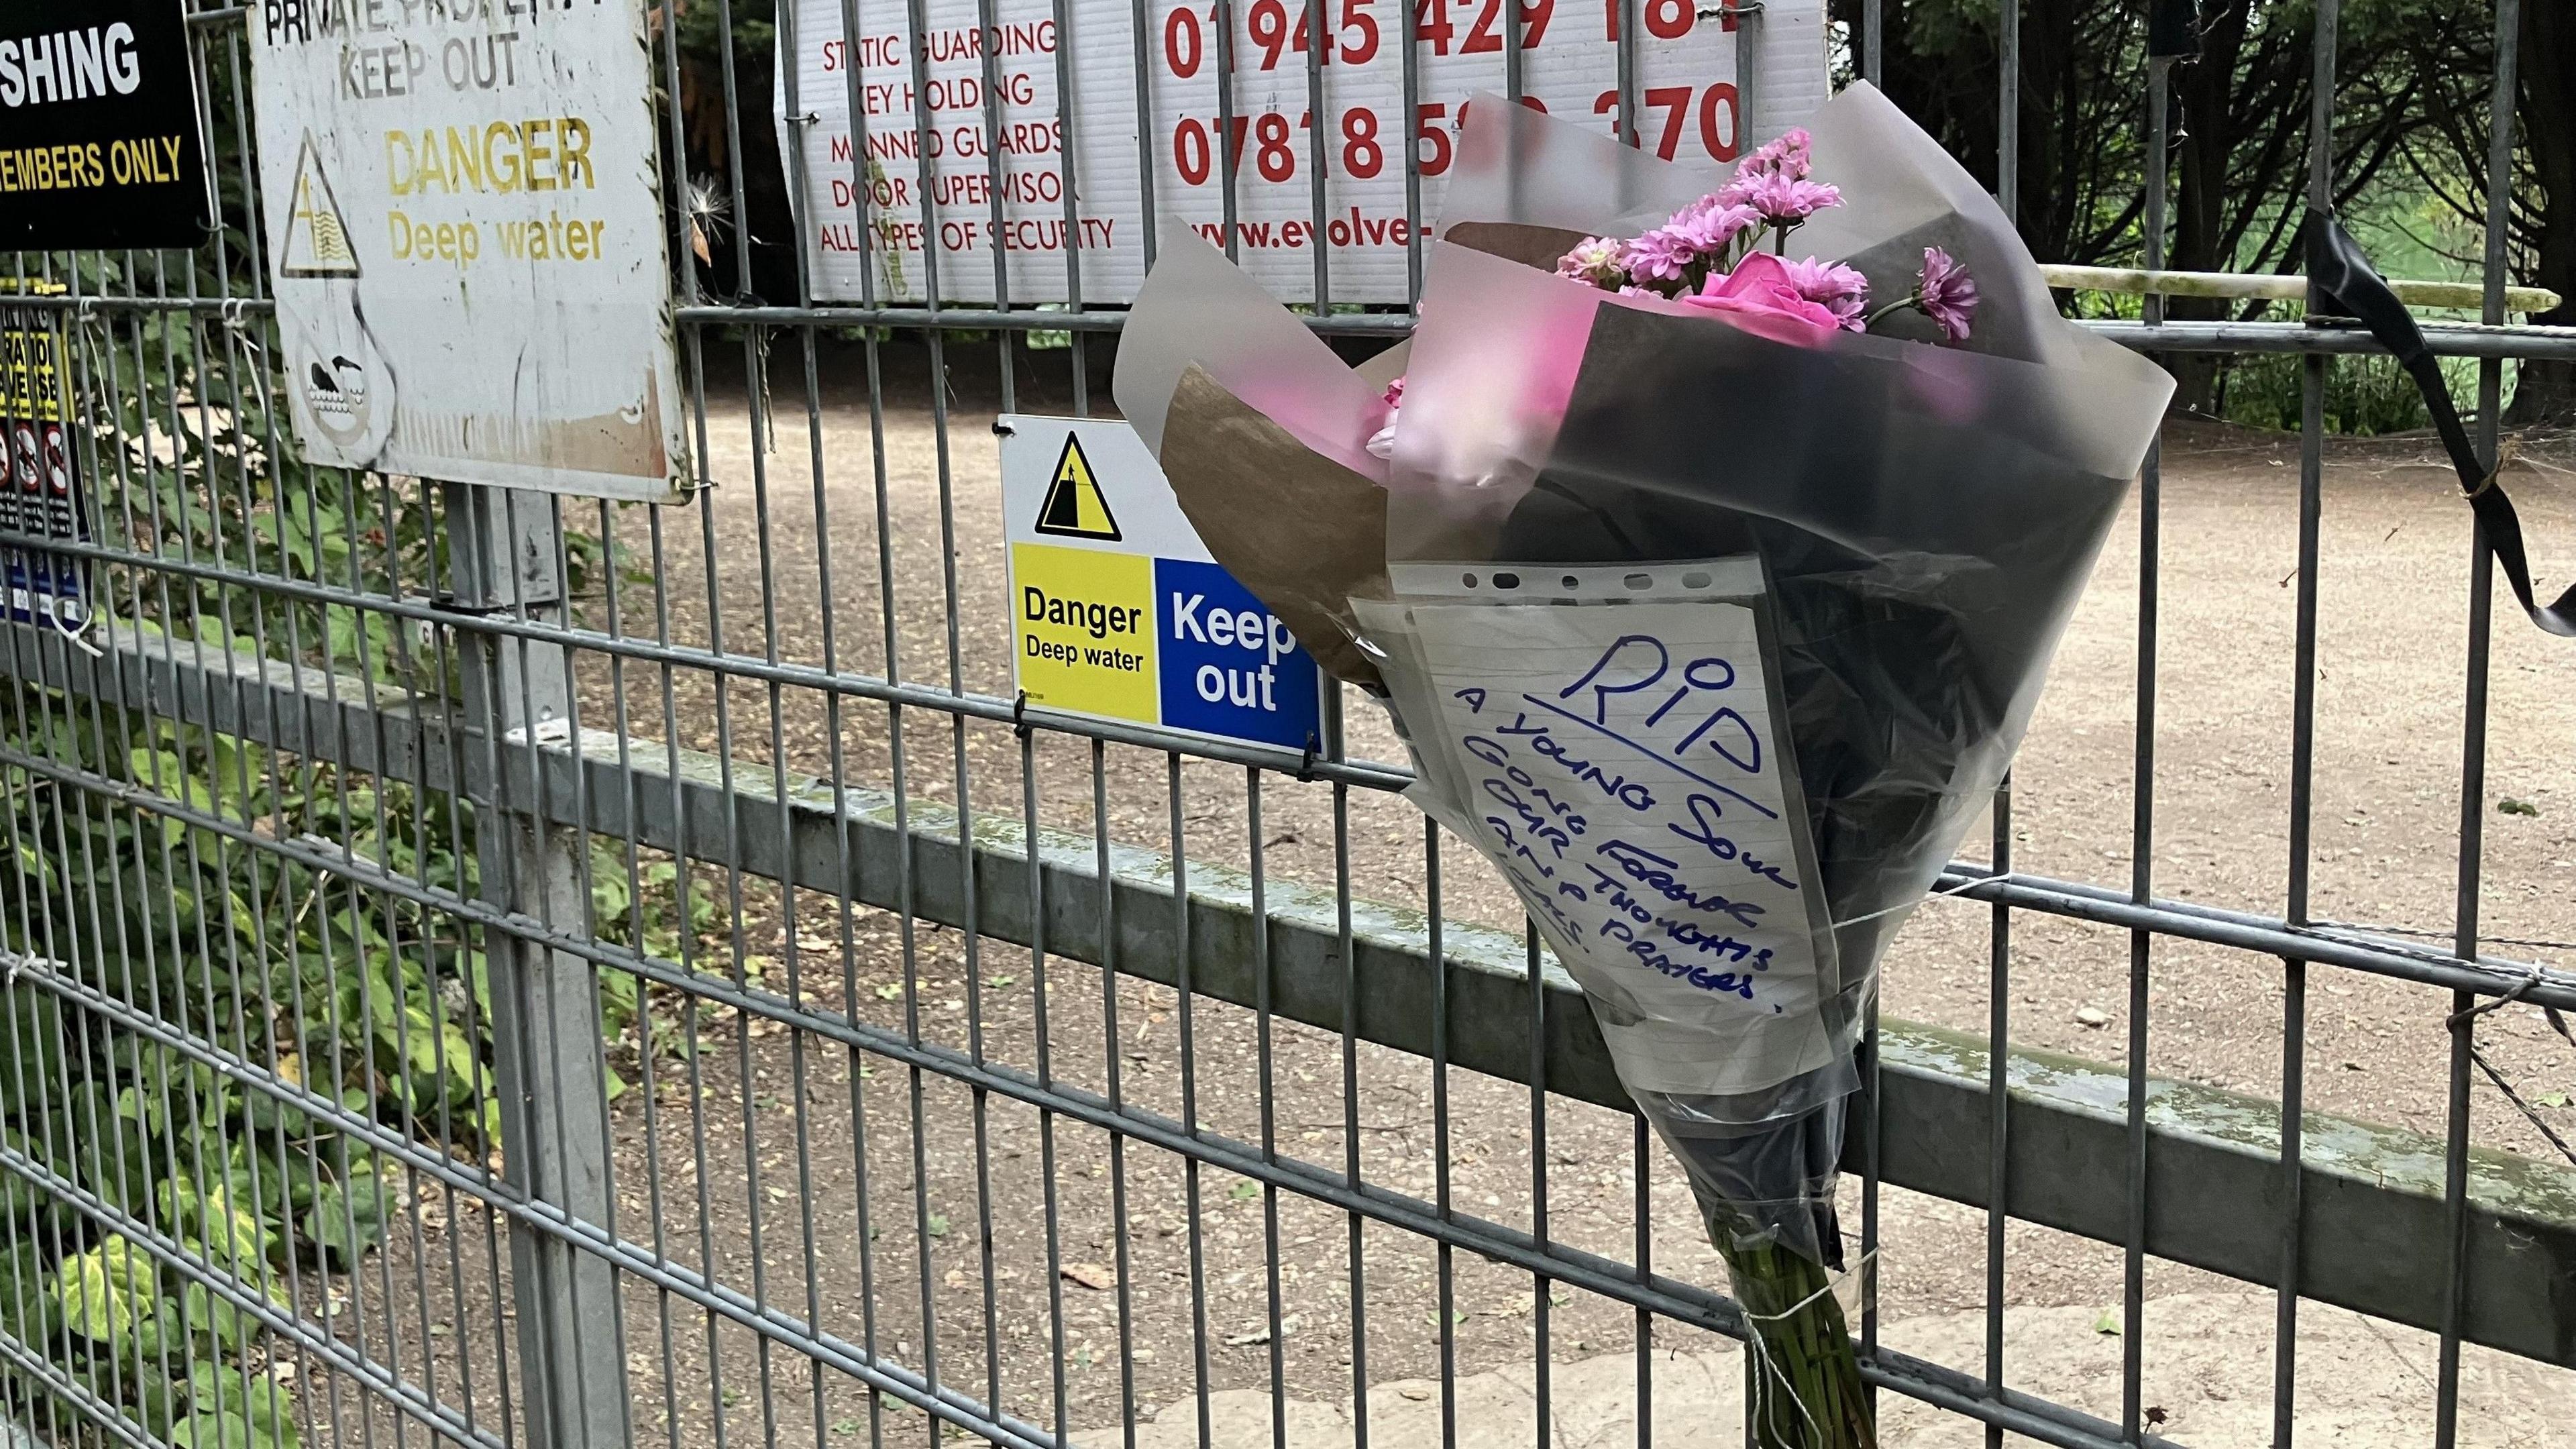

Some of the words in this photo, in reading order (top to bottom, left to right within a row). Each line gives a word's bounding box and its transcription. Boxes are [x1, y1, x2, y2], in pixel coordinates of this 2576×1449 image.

[266, 0, 388, 46] PRIVATE
[0, 22, 140, 107] SHING
[339, 44, 425, 101] KEEP
[443, 32, 519, 92] OUT
[0, 143, 104, 192] EMBERS
[111, 135, 180, 185] ONLY
[384, 117, 595, 196] DANGER
[953, 120, 1063, 157] GUARDS
[917, 171, 1080, 205] UPERVISO
[388, 211, 480, 270] Deep
[496, 209, 604, 262] water
[822, 223, 859, 252] ALL
[941, 222, 977, 252] OF
[1191, 207, 1432, 248] ww.evolve-
[1024, 586, 1142, 639] Danger
[1173, 592, 1297, 665] Keep
[1026, 634, 1078, 667] Deep
[1084, 647, 1144, 672] water
[1196, 664, 1277, 711] out
[1454, 688, 1486, 714] A
[1496, 712, 1656, 811] YOUNG
[1483, 779, 1570, 859] OUR
